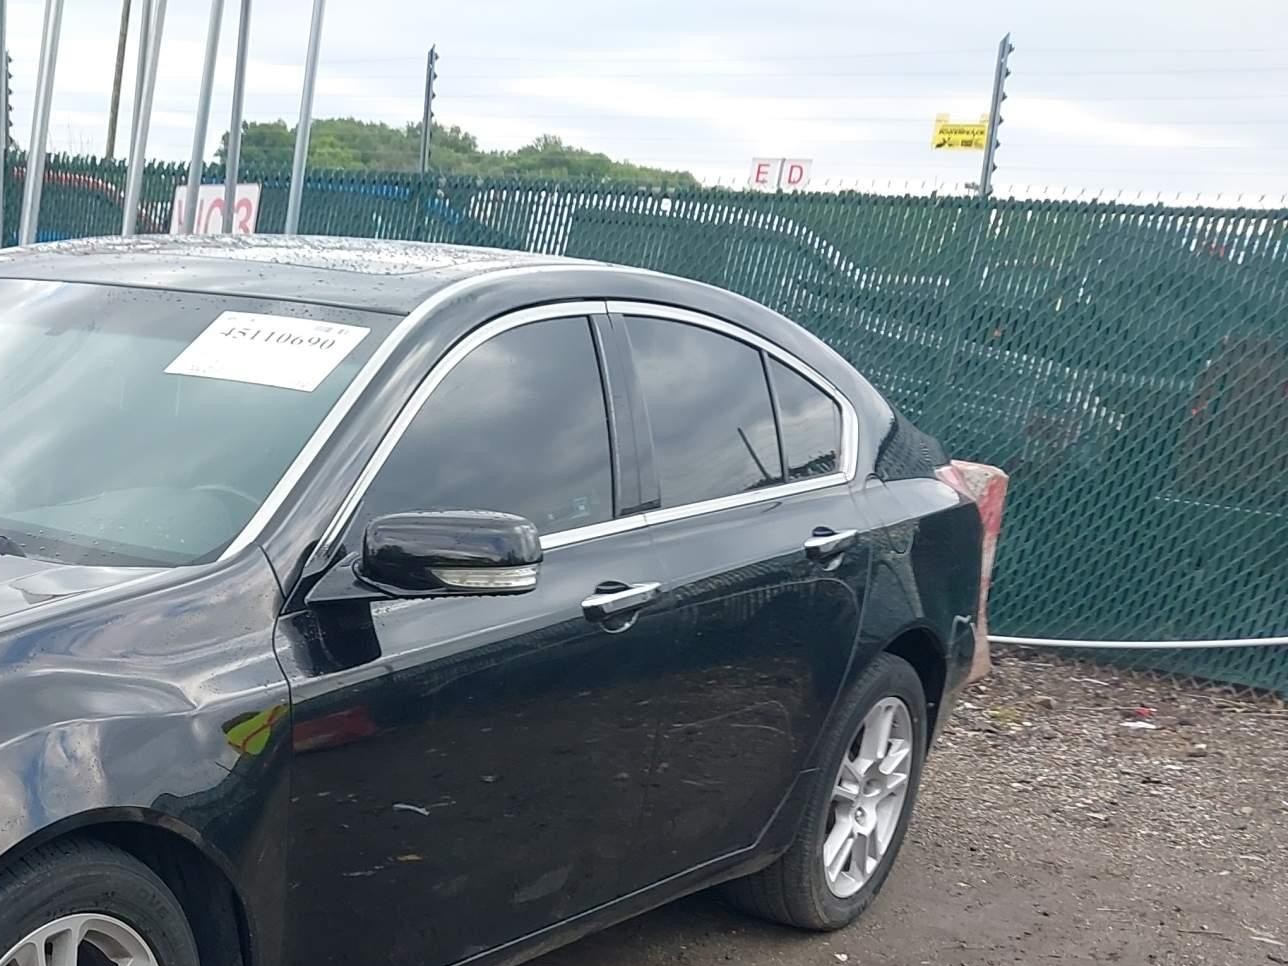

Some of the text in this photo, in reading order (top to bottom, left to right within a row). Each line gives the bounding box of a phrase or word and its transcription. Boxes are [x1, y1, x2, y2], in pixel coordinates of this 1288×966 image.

[755, 163, 804, 185] E D
[219, 326, 336, 350] 45110690
